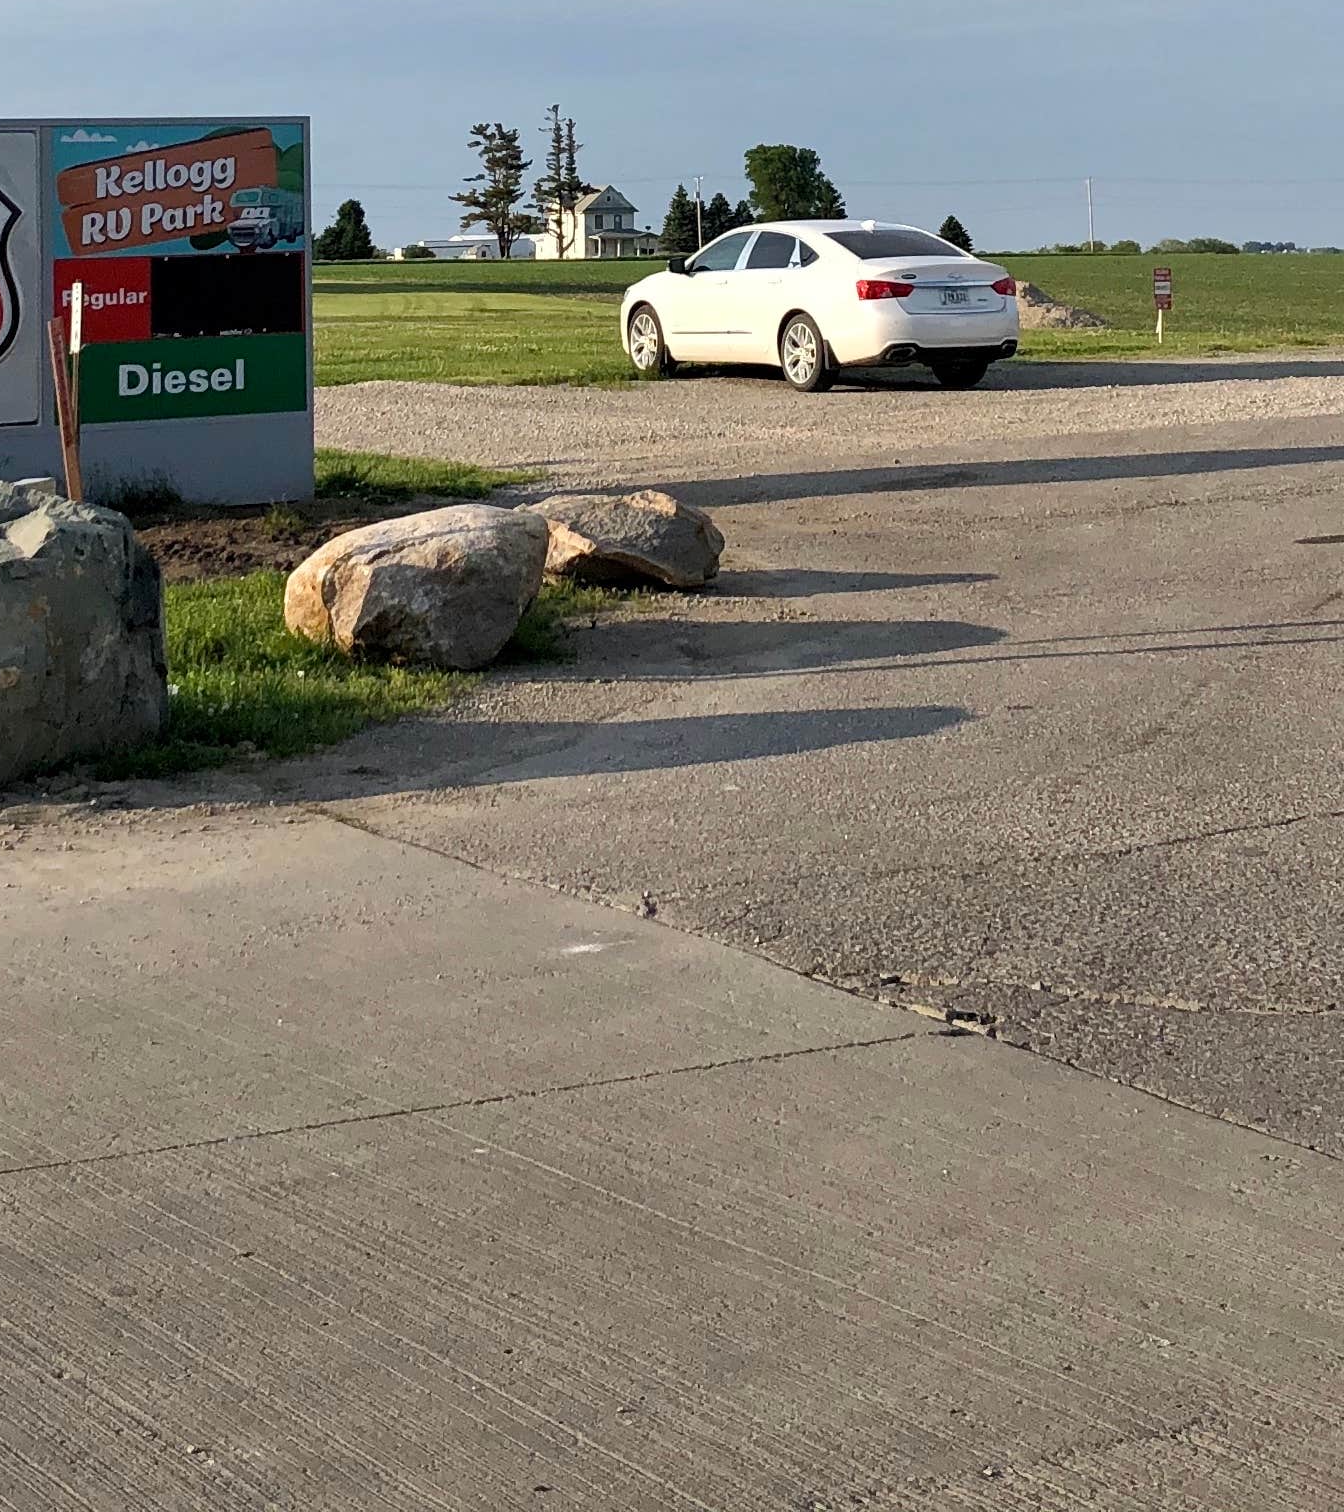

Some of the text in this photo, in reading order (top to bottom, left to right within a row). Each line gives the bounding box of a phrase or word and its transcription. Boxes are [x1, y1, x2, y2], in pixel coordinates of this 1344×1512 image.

[94, 156, 236, 199] Kellogg
[81, 194, 224, 245] RV Park
[118, 358, 245, 396] Diesel
